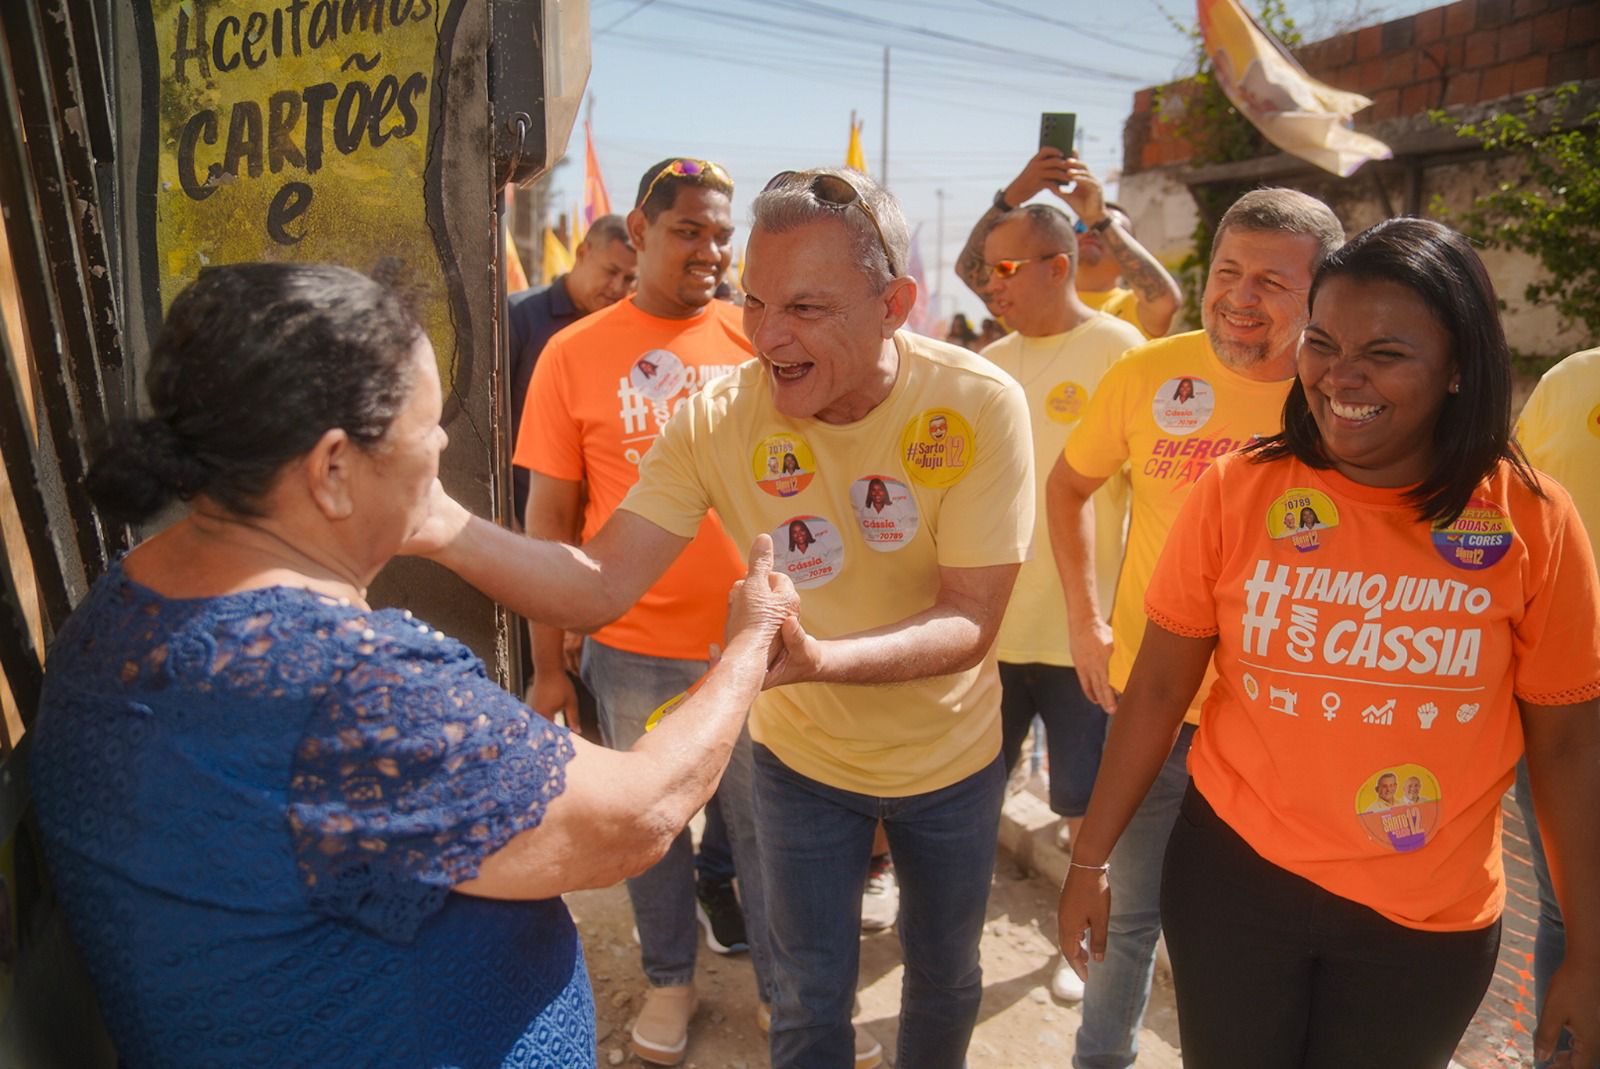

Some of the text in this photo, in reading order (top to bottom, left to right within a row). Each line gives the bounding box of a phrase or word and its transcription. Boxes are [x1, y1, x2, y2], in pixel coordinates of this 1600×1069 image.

[267, 182, 313, 245] e
[945, 435, 965, 467] 12
[921, 454, 943, 470] Juju
[1144, 458, 1211, 483] CRIAT
[863, 519, 896, 529] Cássia
[880, 532, 904, 540] 70789
[1468, 534, 1503, 547] CORES
[788, 557, 822, 572] Cássia
[1286, 604, 1319, 663] COM
[1323, 602, 1481, 677] CÁSSIA
